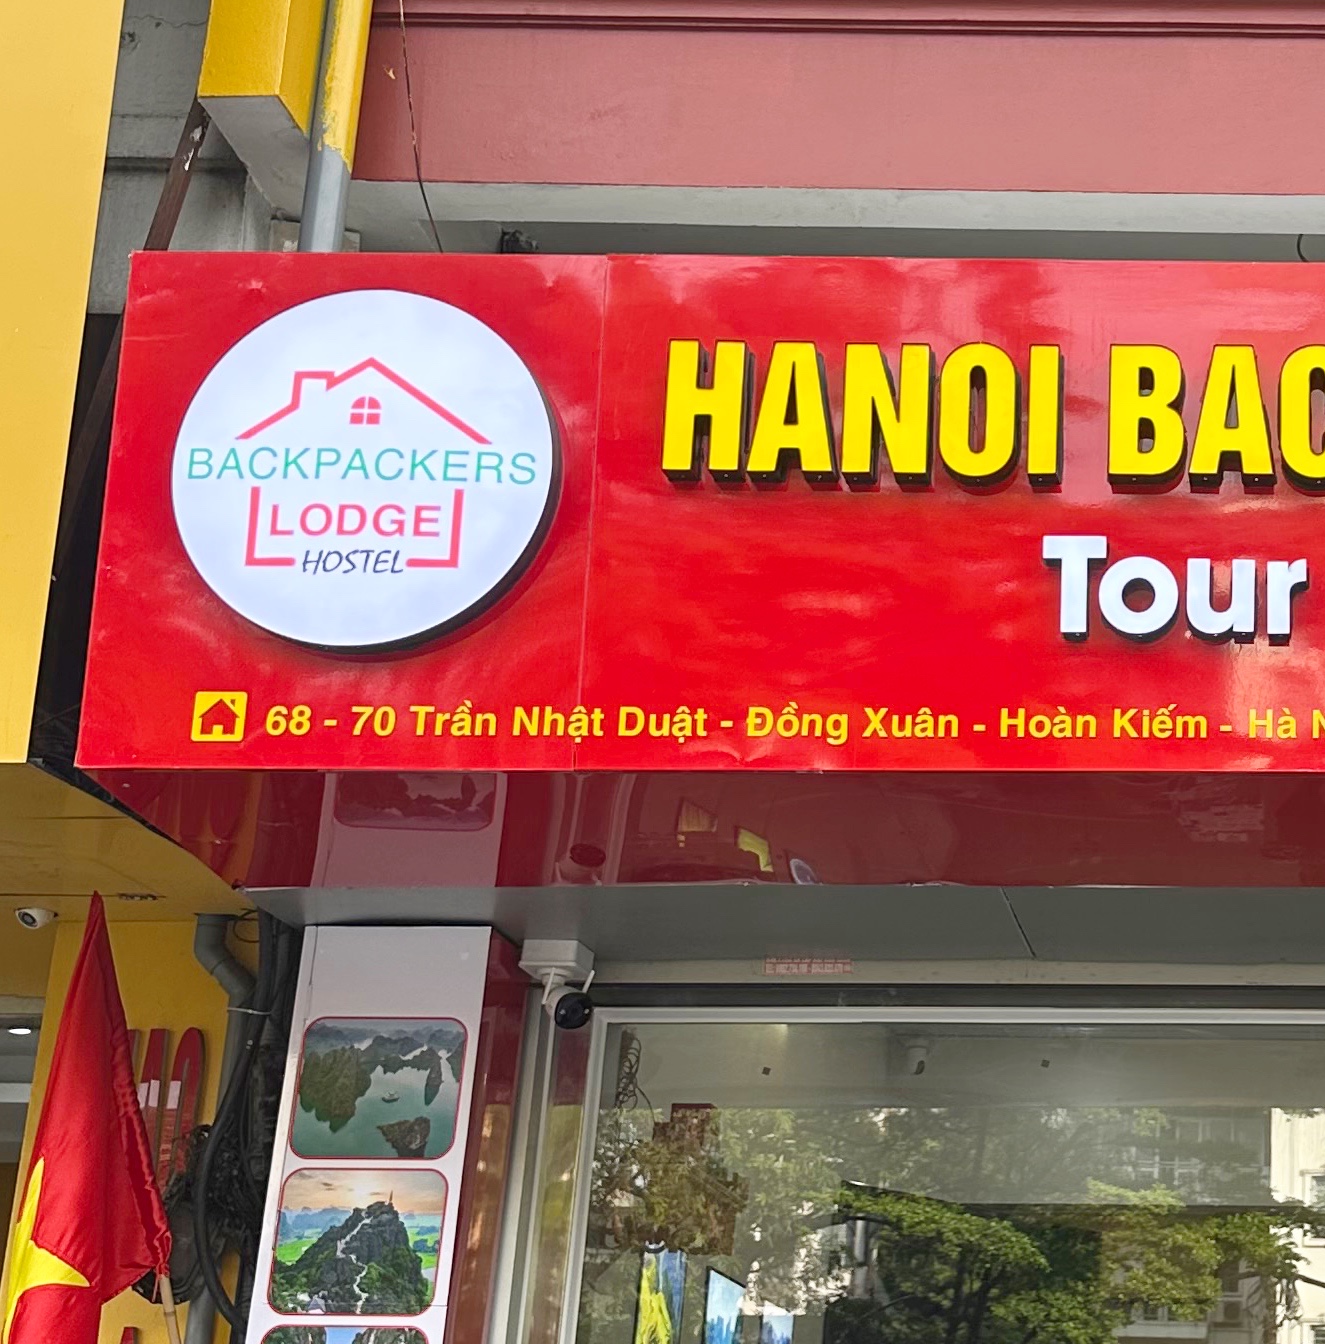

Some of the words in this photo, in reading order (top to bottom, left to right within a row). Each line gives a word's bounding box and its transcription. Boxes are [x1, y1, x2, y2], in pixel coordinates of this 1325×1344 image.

[661, 340, 1062, 484] HANOI
[187, 446, 537, 485] BACKPACKERS
[269, 502, 442, 537] LODGE
[302, 549, 405, 575] HOSTEL
[1042, 535, 1307, 642] Tour
[265, 704, 312, 736] 68
[351, 706, 396, 736] 70
[409, 699, 497, 737] Trần
[512, 705, 605, 743] Nhật
[618, 705, 708, 743] Duật
[746, 701, 849, 745] Đồng
[861, 707, 959, 738] Xuân
[1000, 706, 1097, 738] Hoàn
[1113, 703, 1207, 739] Kiếm
[1248, 708, 1297, 739] Hà
